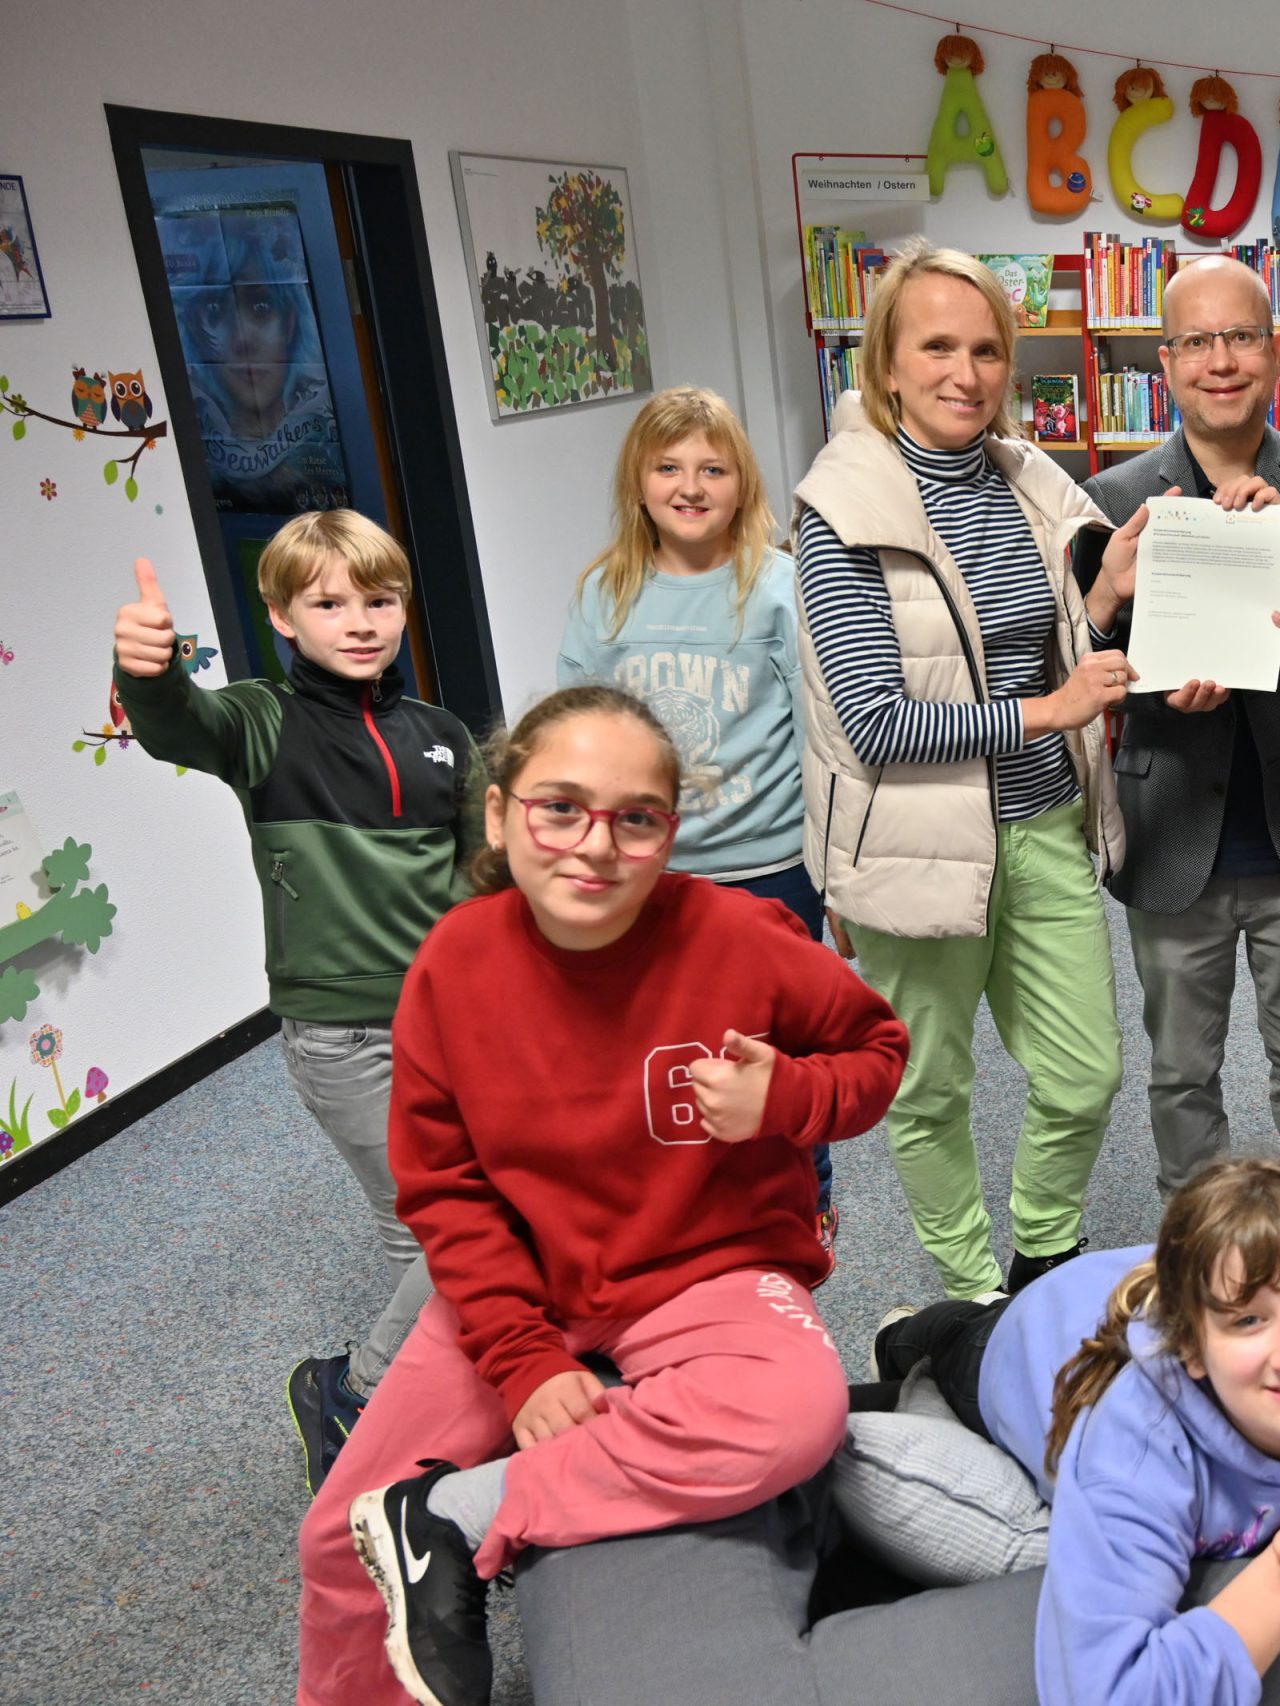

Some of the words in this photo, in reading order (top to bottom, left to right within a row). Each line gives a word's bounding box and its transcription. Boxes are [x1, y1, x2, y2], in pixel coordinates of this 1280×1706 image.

[925, 67, 1009, 197] A
[1027, 88, 1092, 215] B
[1108, 97, 1185, 220] C
[1181, 110, 1262, 238] D
[808, 179, 871, 191] Weihnachten
[883, 179, 916, 191] Ostern
[1004, 269, 1018, 277] Das
[207, 418, 322, 473] Seawalkers
